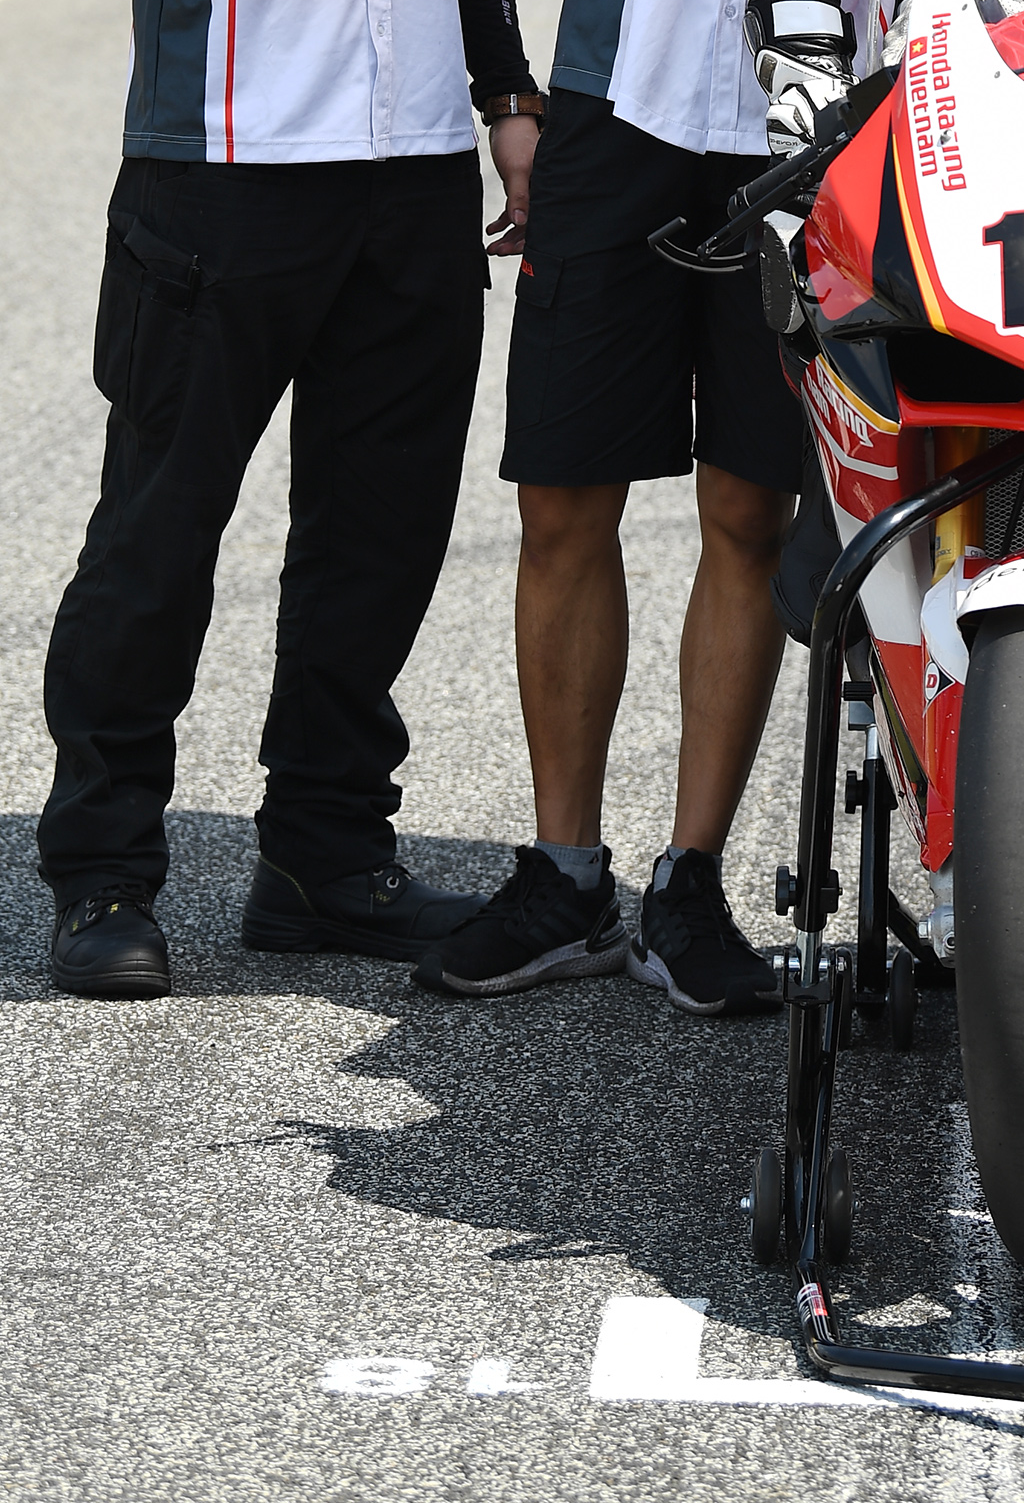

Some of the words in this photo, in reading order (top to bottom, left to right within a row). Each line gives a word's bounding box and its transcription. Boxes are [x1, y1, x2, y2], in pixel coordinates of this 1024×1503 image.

[931, 12, 953, 93] Honda
[908, 60, 938, 178] Vietnam
[938, 95, 967, 192] Raing
